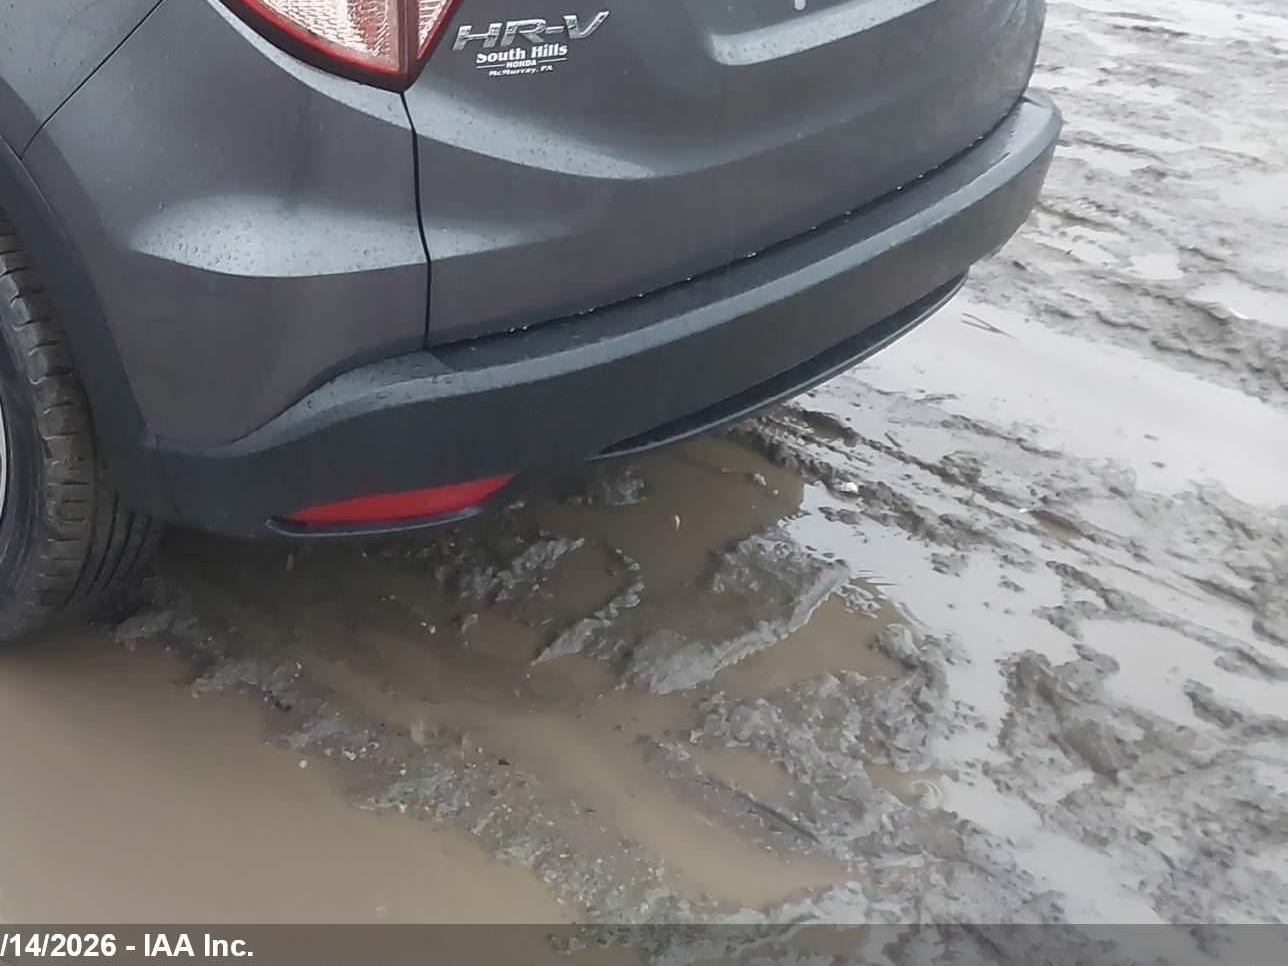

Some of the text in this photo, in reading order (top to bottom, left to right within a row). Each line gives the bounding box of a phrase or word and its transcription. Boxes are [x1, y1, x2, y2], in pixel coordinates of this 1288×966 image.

[452, 10, 609, 50] HR-V
[476, 43, 568, 64] South Hills
